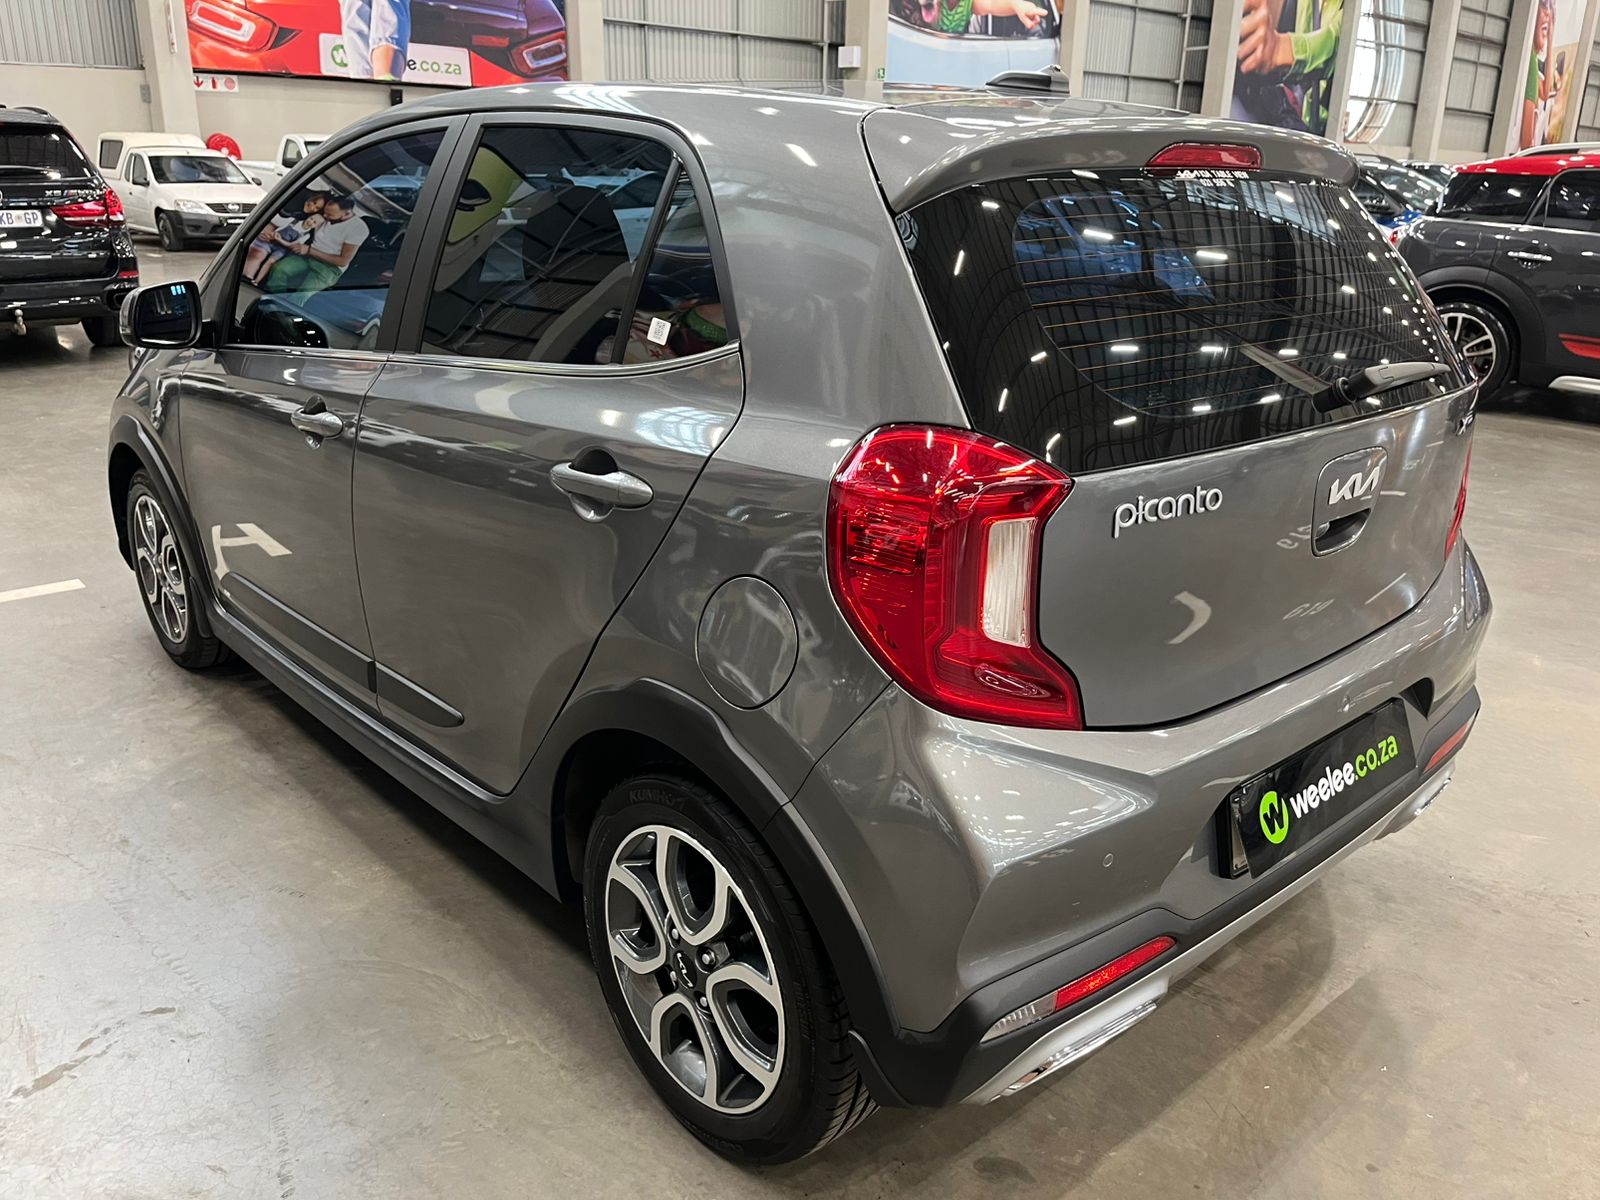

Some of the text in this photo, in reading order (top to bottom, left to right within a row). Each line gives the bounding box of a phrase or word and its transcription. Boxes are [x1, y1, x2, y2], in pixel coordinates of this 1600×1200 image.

[24, 212, 38, 224] GP
[1112, 485, 1223, 539] picanto
[1289, 735, 1399, 819] weelee.co.za
